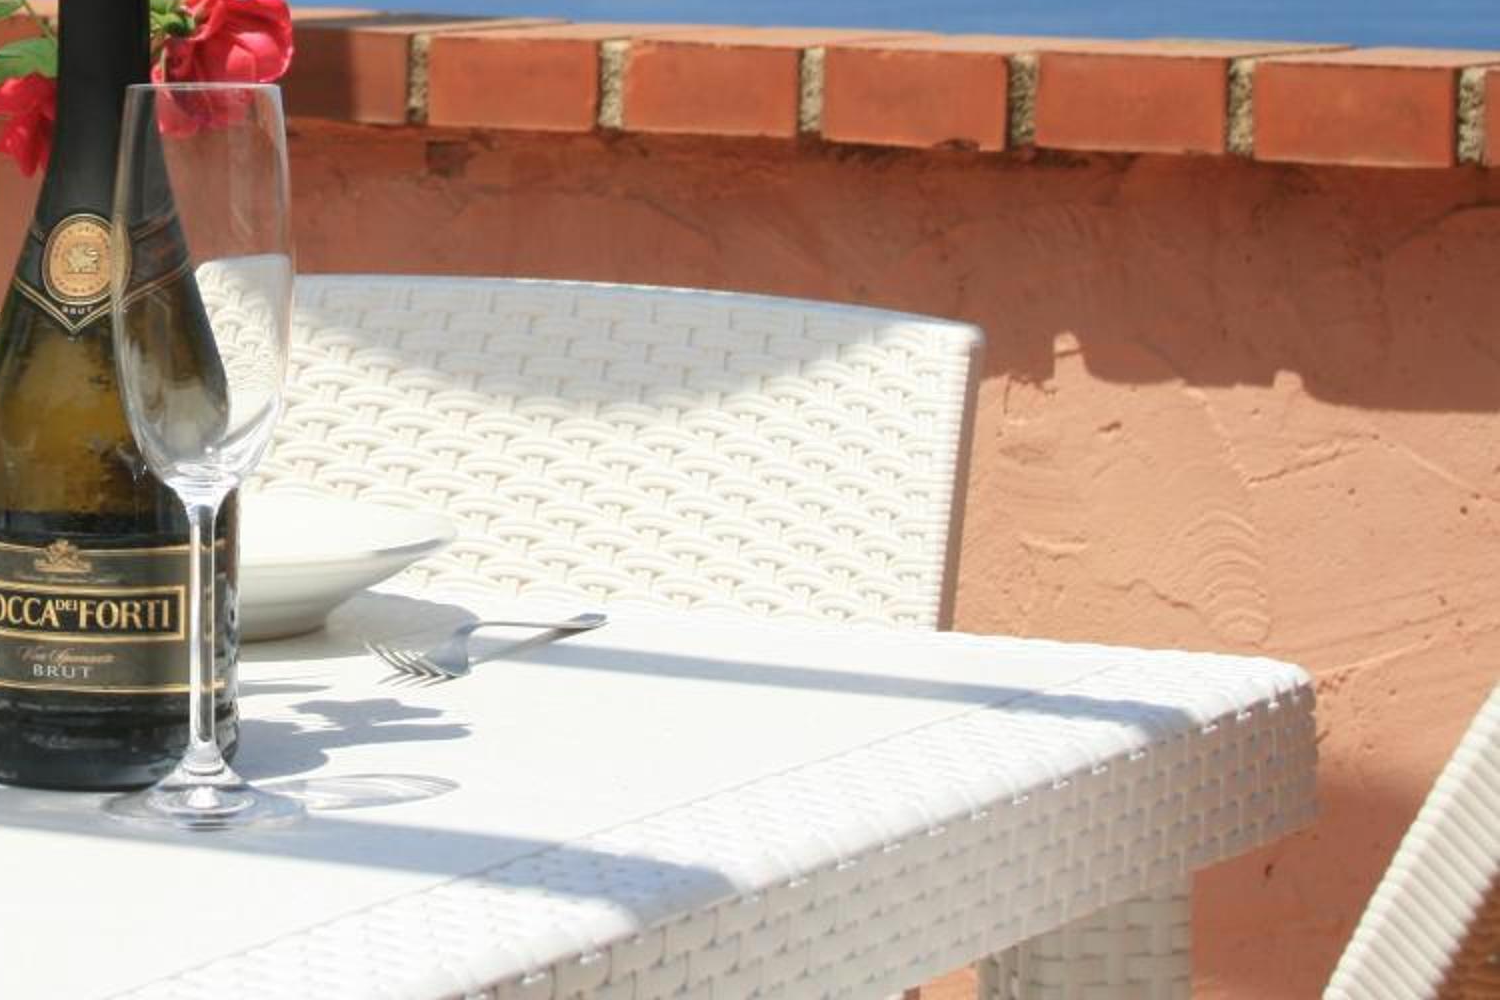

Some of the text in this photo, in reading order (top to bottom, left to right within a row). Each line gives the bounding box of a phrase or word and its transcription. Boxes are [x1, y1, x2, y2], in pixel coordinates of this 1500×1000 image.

[61, 305, 94, 315] BRUT
[55, 599, 78, 612] DEI
[78, 600, 170, 629] FORTI
[32, 663, 94, 679] BRUT
